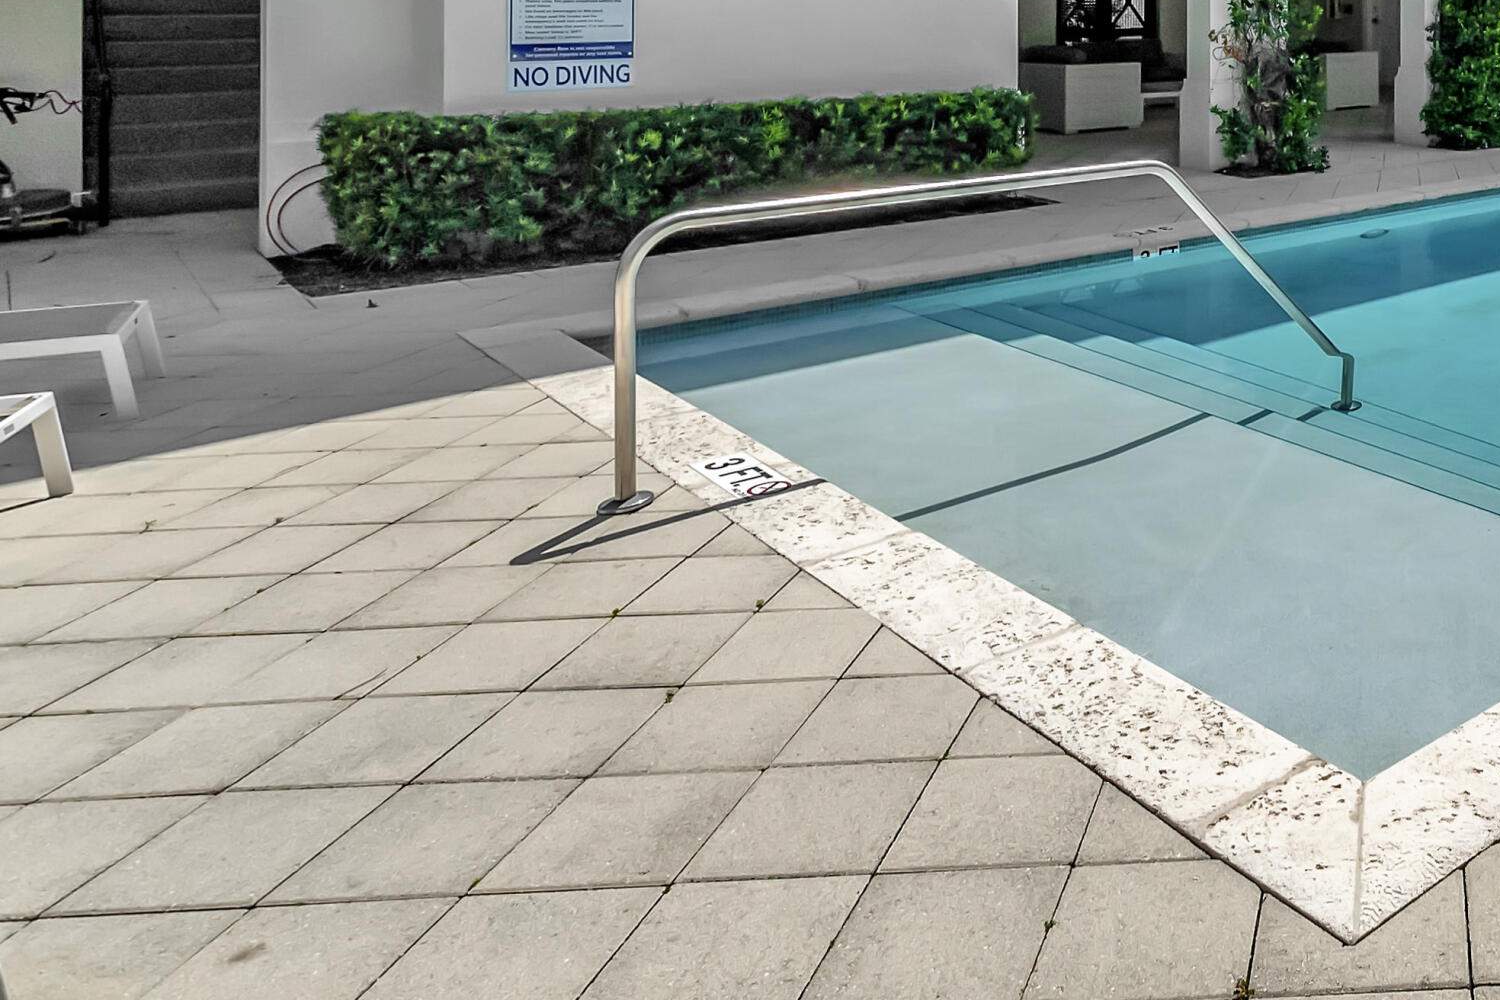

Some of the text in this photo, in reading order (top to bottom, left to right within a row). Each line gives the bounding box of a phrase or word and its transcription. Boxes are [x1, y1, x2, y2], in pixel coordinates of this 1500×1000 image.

[513, 63, 630, 87] NO DIVING
[704, 457, 746, 471] 3
